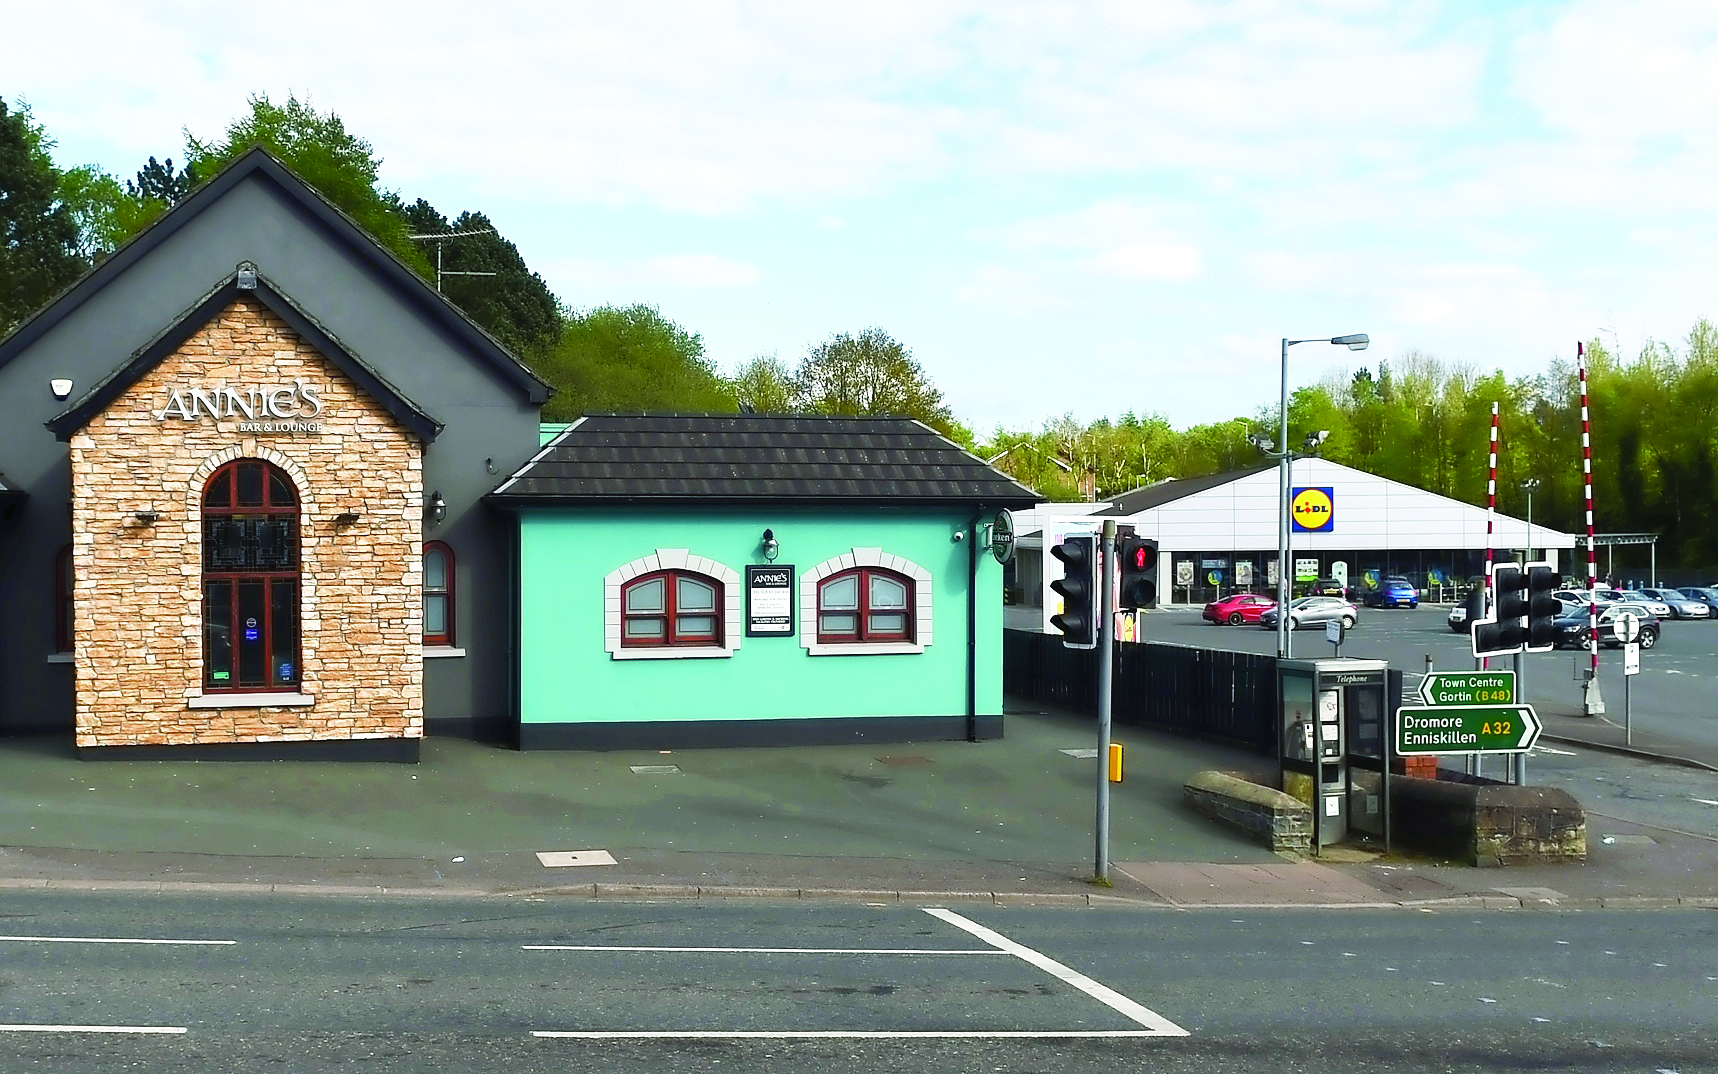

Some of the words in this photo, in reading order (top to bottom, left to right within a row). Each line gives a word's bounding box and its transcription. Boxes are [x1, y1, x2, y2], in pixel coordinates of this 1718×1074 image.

[156, 378, 322, 421] ANNIE'S
[239, 423, 262, 432] BAR
[263, 423, 273, 432] &
[275, 423, 322, 432] LOUNGE
[754, 573, 787, 583] ANNIE'S
[1336, 675, 1368, 684] Telephone
[1439, 678, 1466, 688] Town
[1468, 677, 1504, 687] Centre
[1439, 692, 1472, 702] Gortin
[1404, 715, 1463, 729] Dromore
[1404, 731, 1477, 745] Enniskillen
